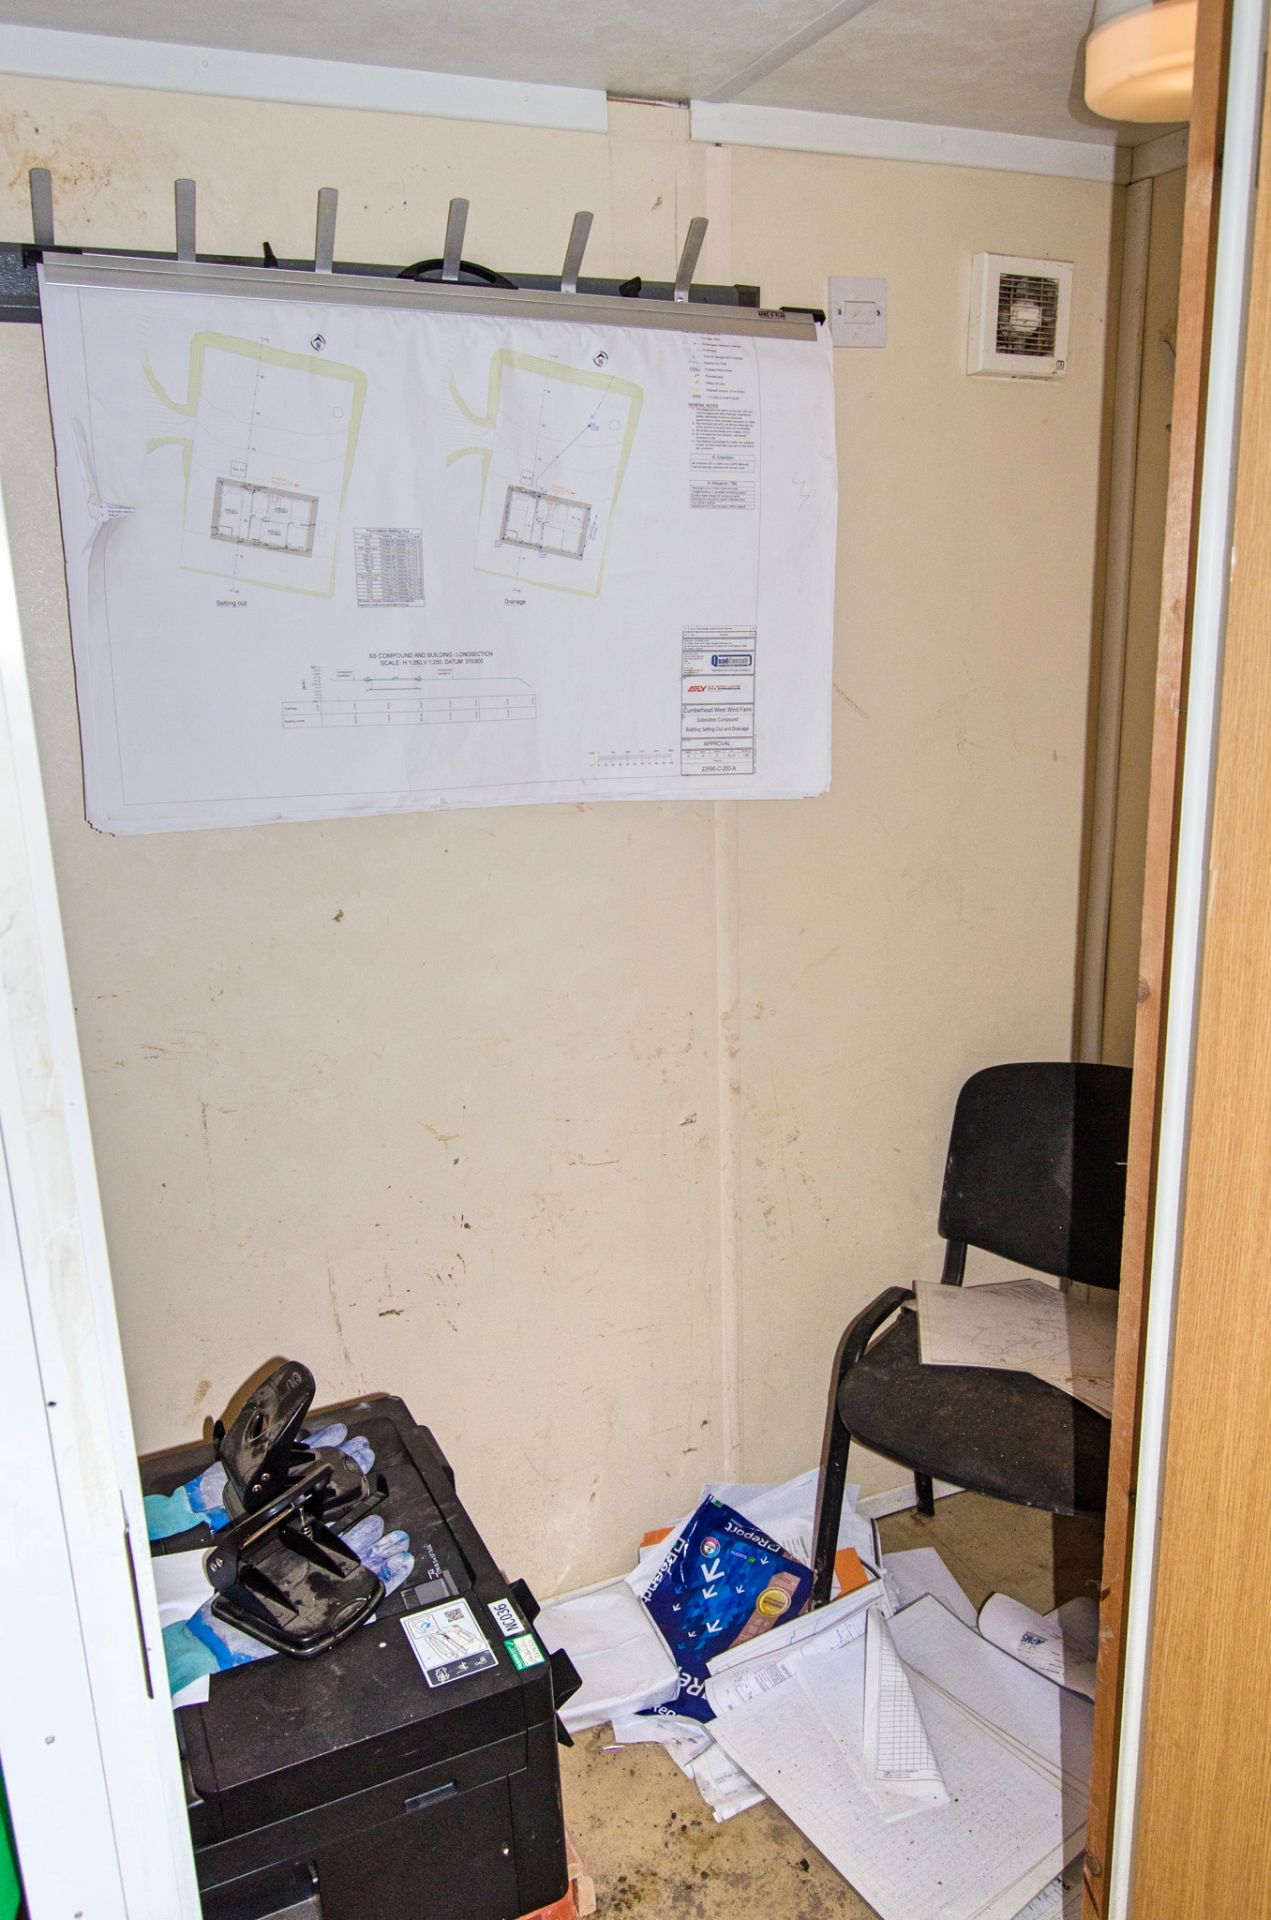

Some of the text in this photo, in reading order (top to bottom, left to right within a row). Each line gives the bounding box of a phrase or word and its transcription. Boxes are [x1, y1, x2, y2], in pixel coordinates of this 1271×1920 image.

[216, 599, 237, 607] Setting
[504, 597, 526, 606] Drainage
[378, 652, 412, 660] COMPOUND
[683, 706, 713, 714] Cumberhead
[724, 1521, 770, 1548] Report
[493, 1603, 520, 1632] NC036
